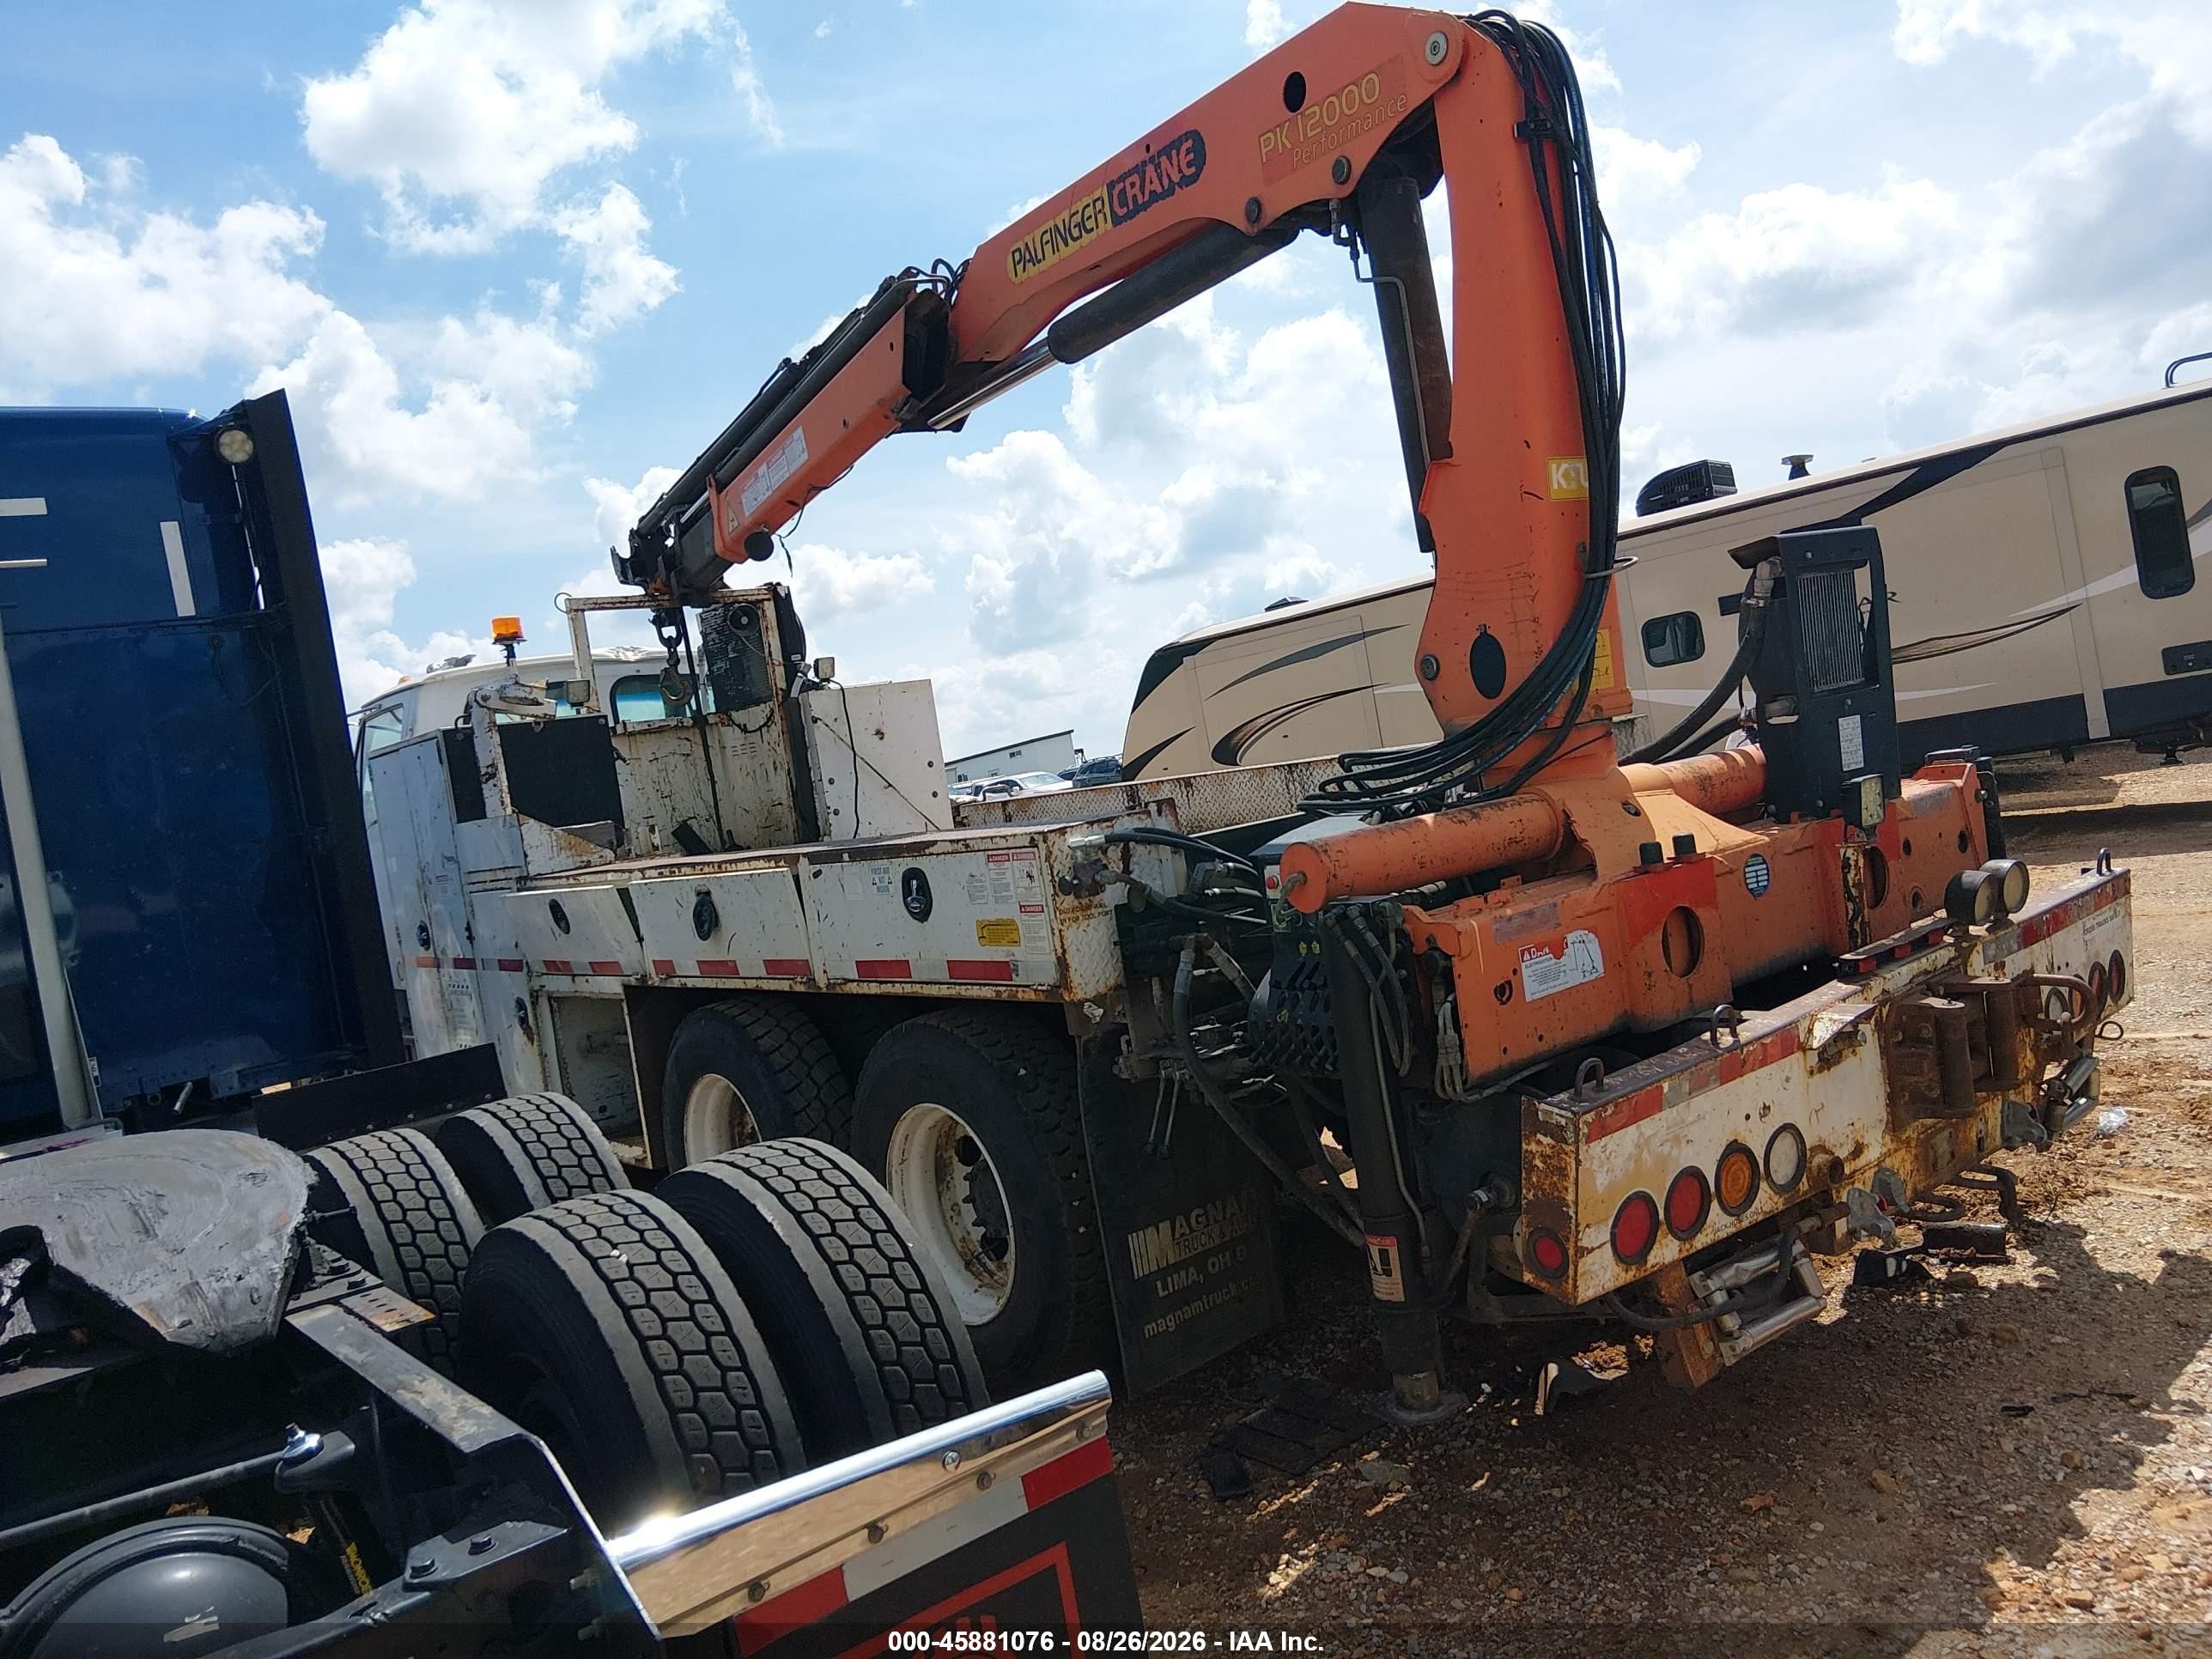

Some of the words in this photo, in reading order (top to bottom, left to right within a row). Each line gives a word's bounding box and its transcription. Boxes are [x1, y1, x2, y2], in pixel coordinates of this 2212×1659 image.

[1259, 121, 1292, 163] PK
[1297, 72, 1381, 143] 12000
[1292, 94, 1407, 169] Performance
[1011, 195, 1108, 278] PALFINGER
[1111, 138, 1197, 217] CRANE
[1176, 1227, 1216, 1259] TRUCK
[1156, 1266, 1205, 1298] LIMA,
